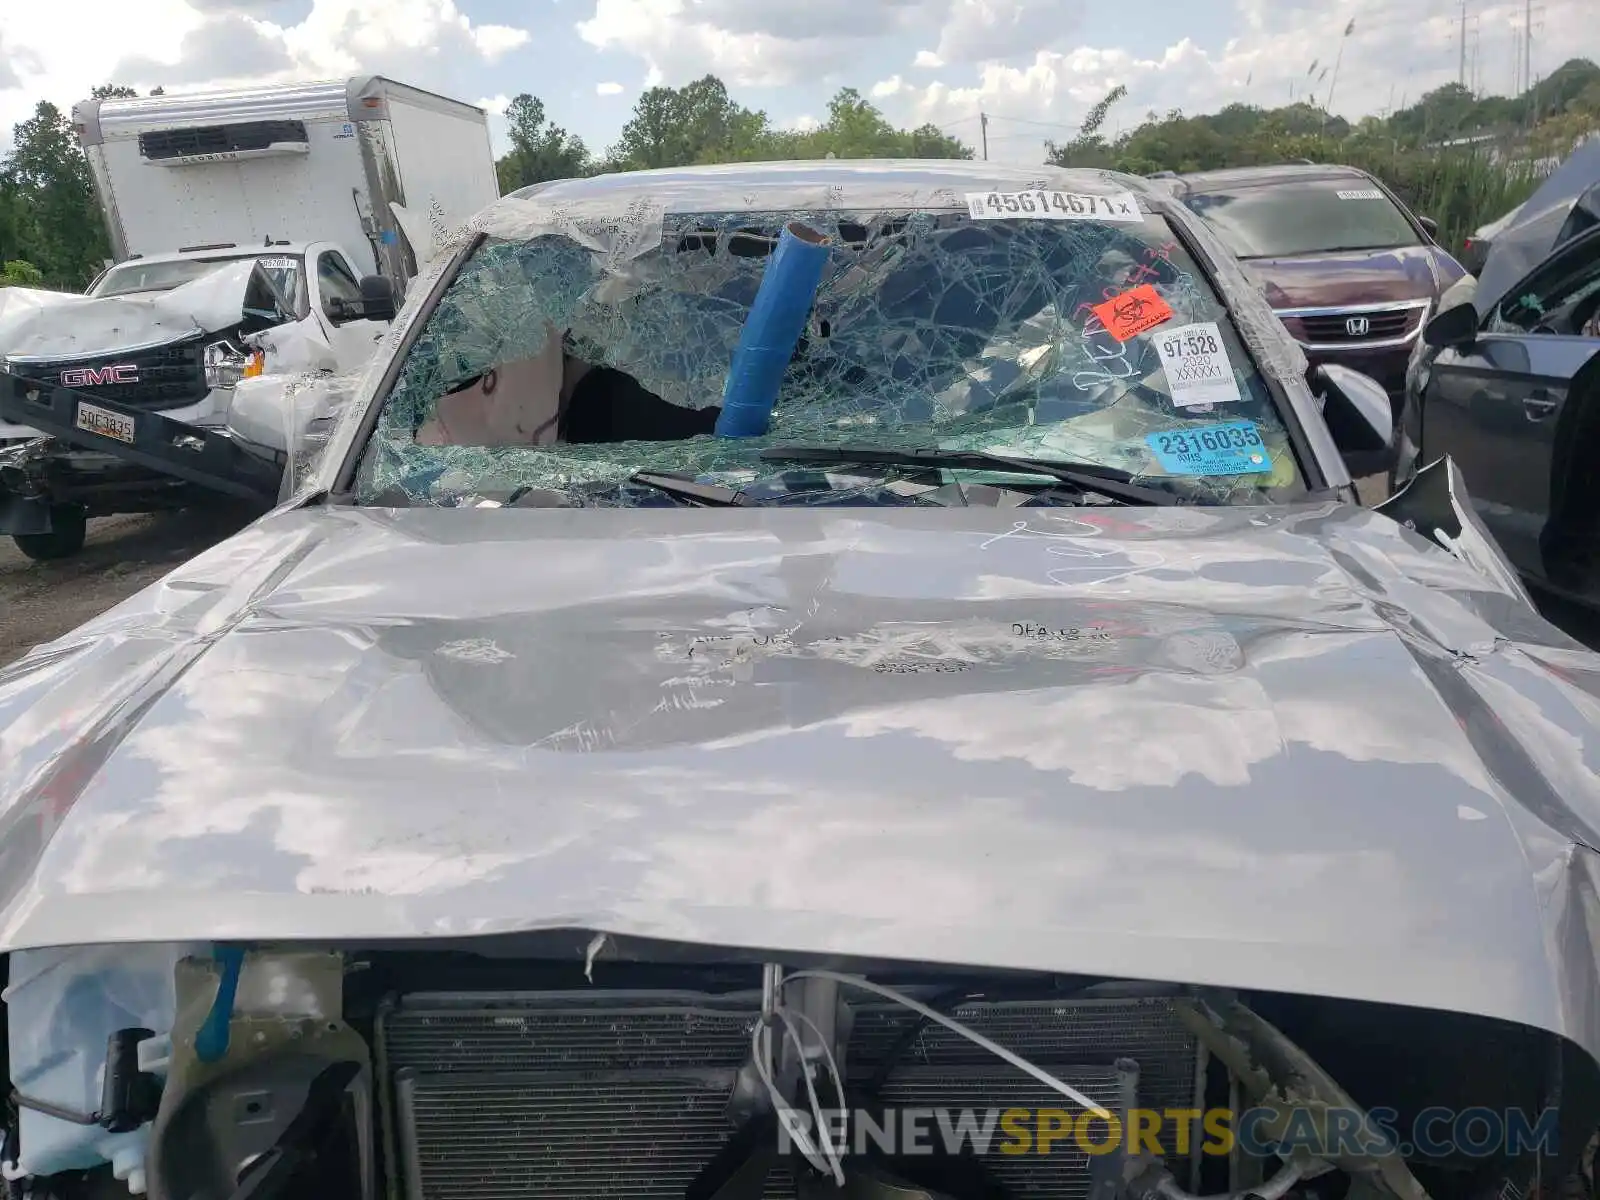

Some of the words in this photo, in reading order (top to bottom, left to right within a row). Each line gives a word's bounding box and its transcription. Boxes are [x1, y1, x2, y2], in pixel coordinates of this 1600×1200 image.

[986, 192, 1115, 215] 45614671
[1182, 355, 1211, 368] 2020
[60, 364, 139, 388] GMC
[1158, 427, 1261, 455] 2316035
